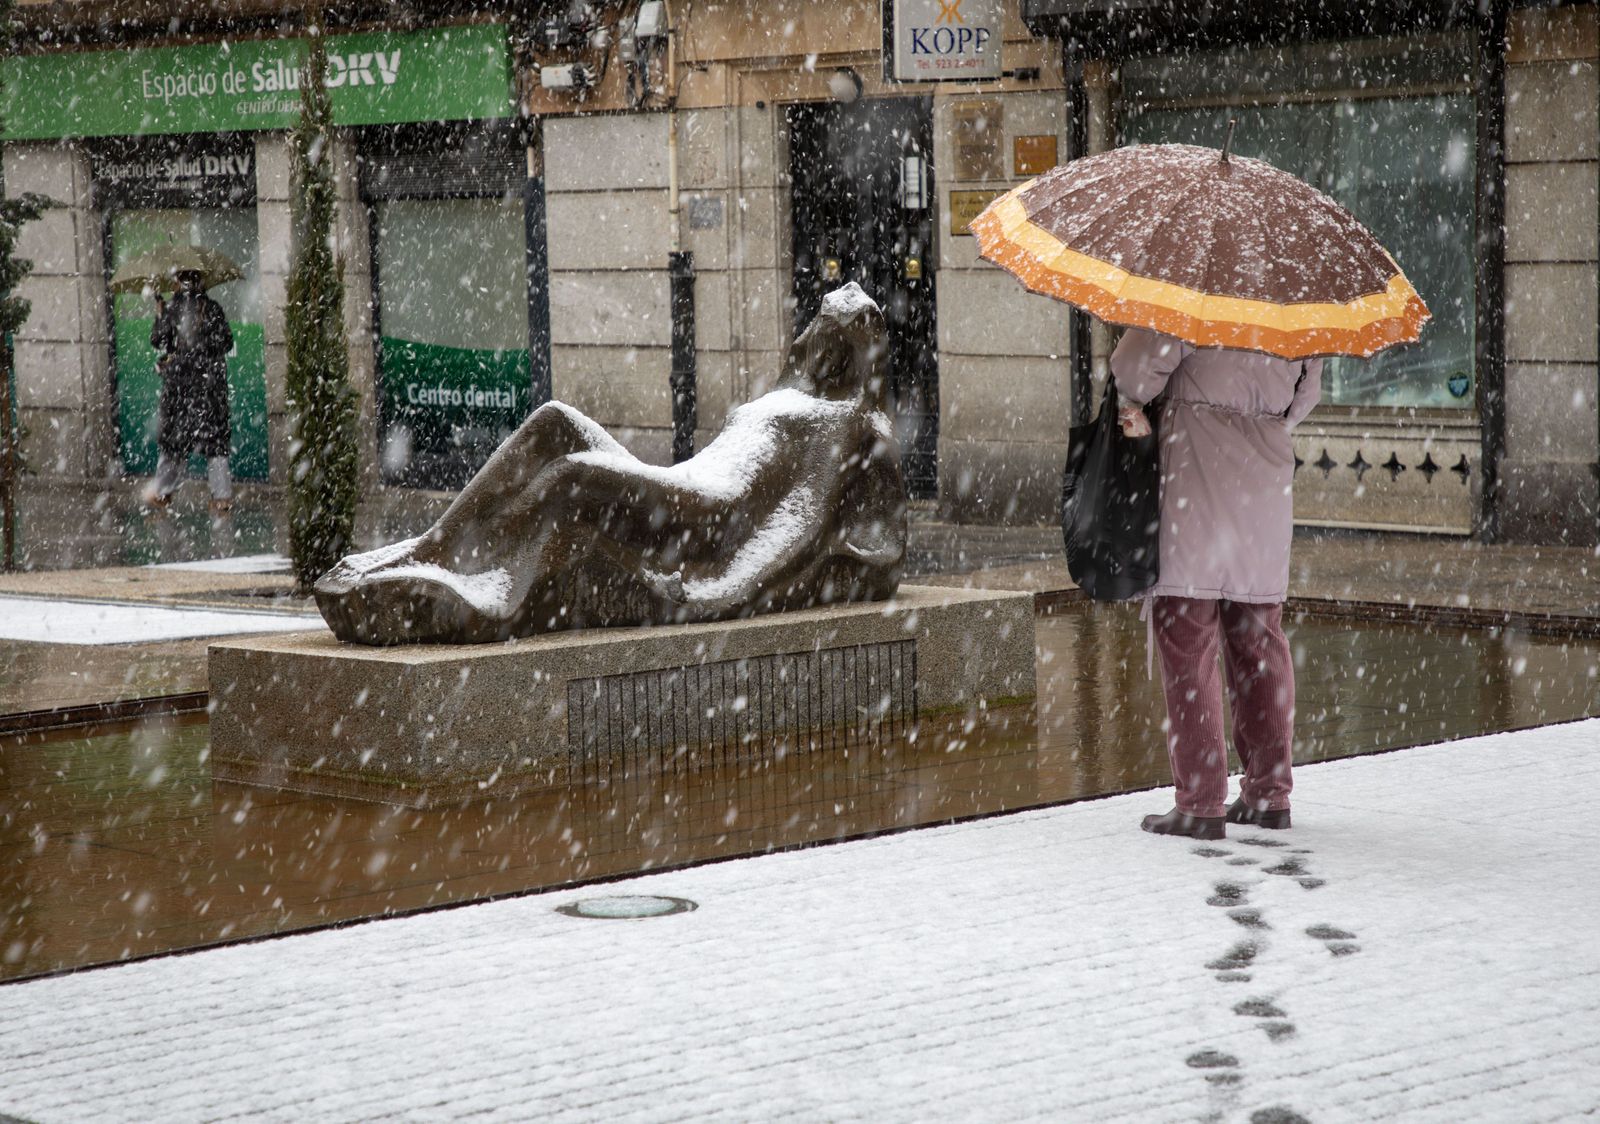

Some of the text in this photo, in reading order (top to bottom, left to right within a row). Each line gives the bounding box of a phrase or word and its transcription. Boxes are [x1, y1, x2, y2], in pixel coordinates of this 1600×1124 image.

[911, 27, 991, 54] KOPP
[142, 49, 401, 106] Espacio de Salu DKV
[236, 100, 276, 114] CENTRO
[99, 153, 251, 181] Espacio de Salud DKV
[407, 383, 517, 408] Centro dental
